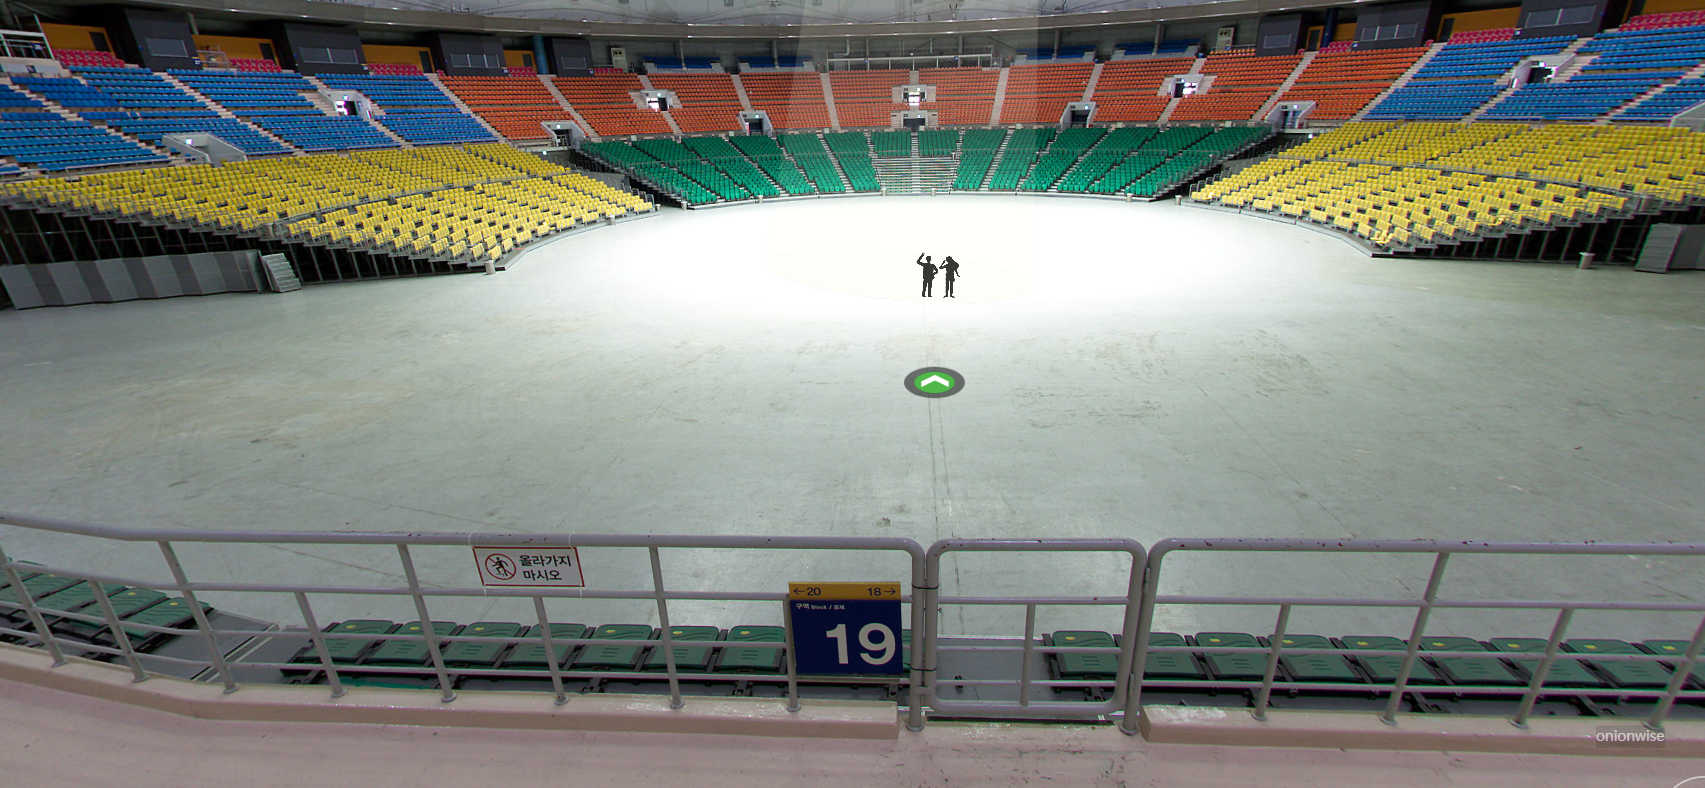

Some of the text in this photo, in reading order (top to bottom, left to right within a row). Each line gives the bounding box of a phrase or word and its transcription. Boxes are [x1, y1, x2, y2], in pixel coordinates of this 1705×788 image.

[519, 555, 572, 567] 올라가지
[523, 569, 563, 581] 마시오
[806, 586, 821, 596] 20
[867, 587, 882, 596] 18
[795, 602, 810, 610] 구역
[826, 622, 896, 665] 19
